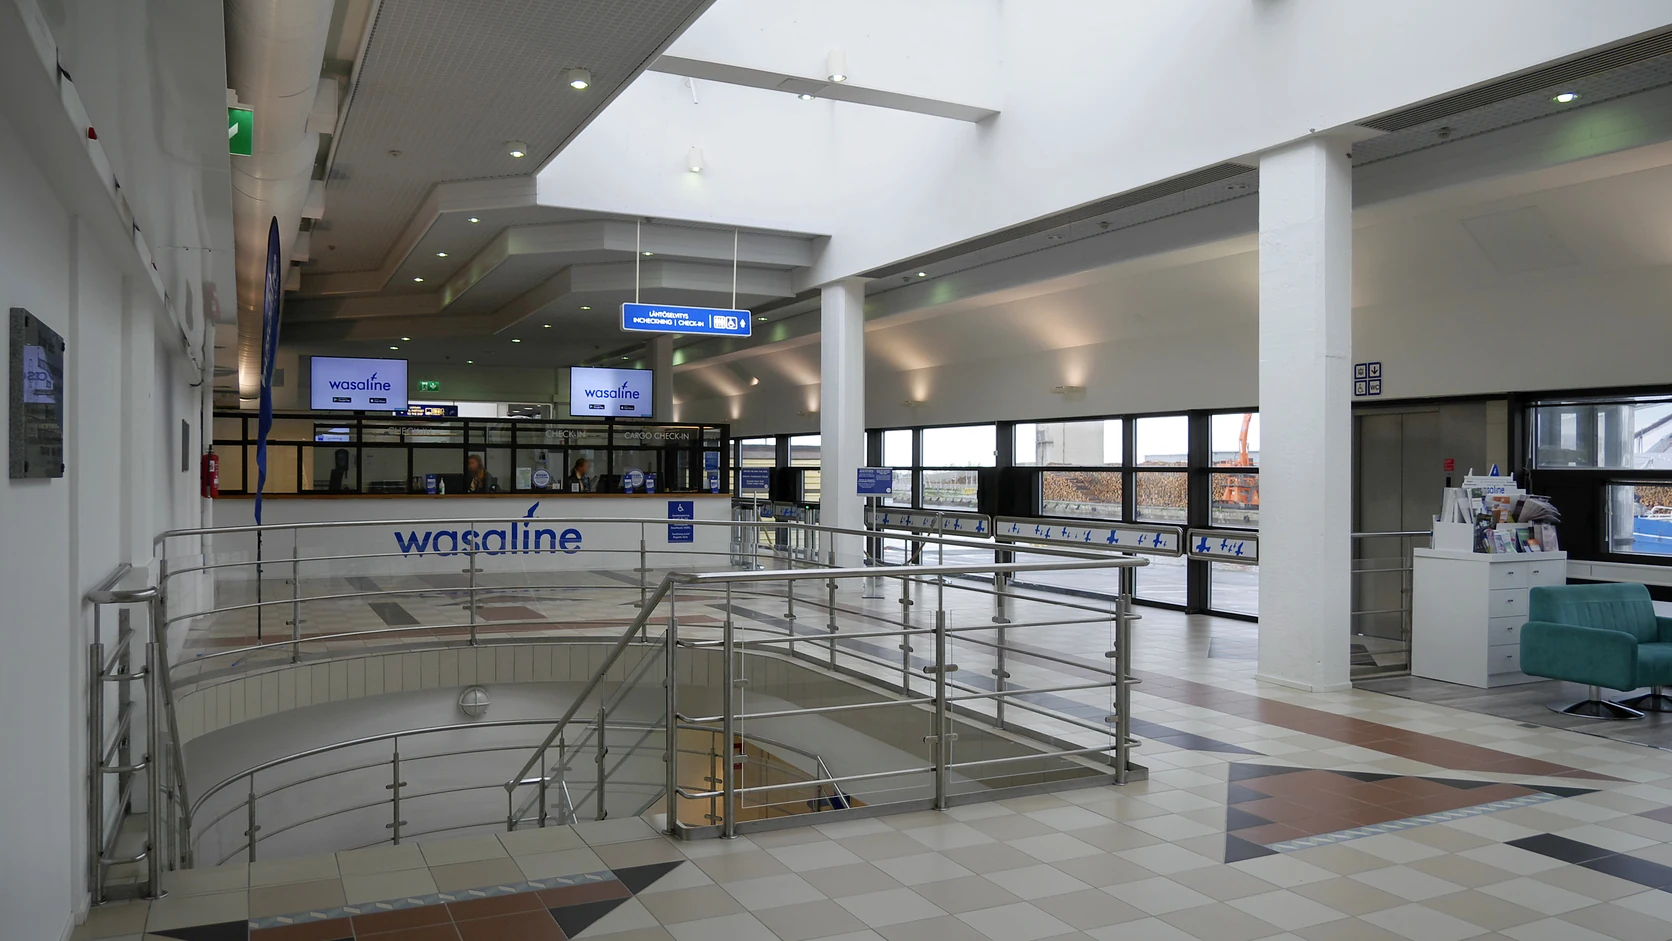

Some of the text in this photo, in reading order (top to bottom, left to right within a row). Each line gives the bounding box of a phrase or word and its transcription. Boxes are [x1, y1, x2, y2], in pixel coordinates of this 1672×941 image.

[329, 372, 391, 391] wasaline
[585, 381, 640, 399] wasaline
[545, 430, 586, 438] CHECK-IN
[624, 431, 690, 440] CARGO CHECK-IN
[394, 502, 582, 558] wasaline
